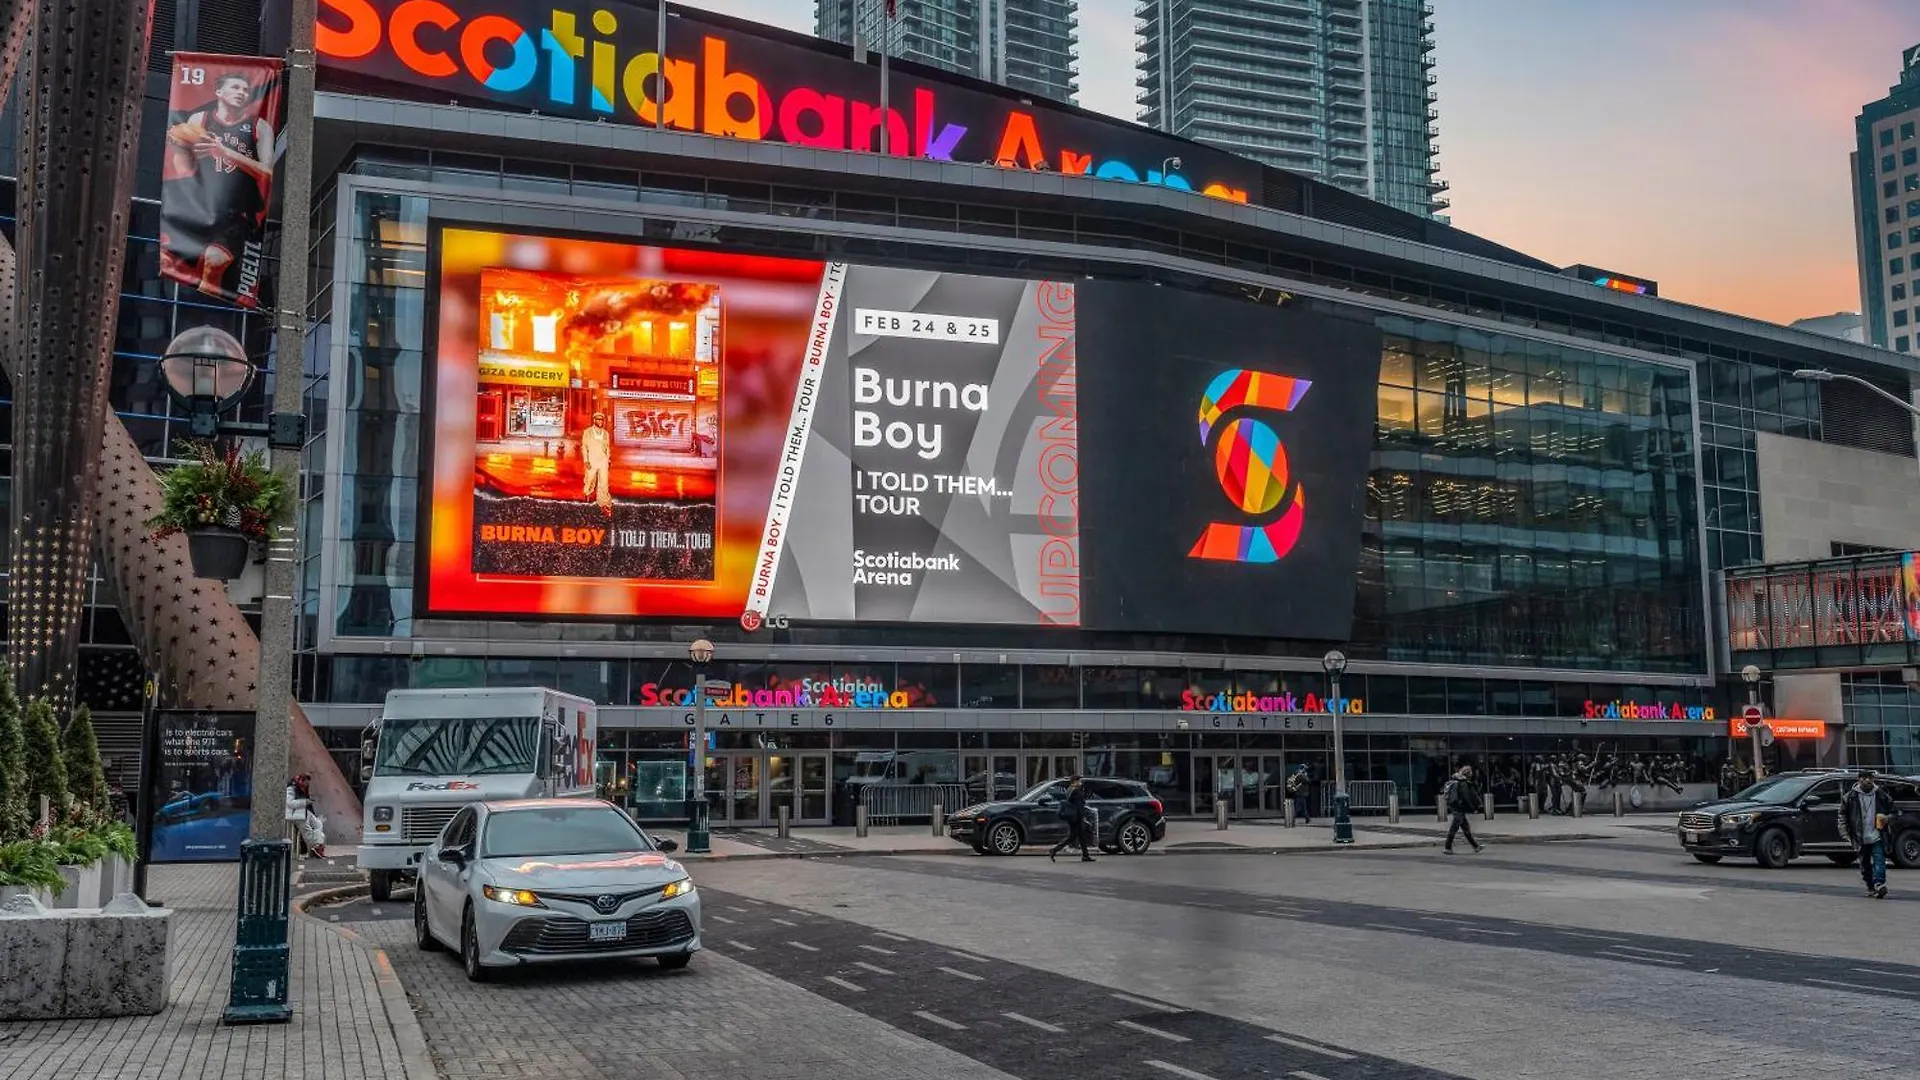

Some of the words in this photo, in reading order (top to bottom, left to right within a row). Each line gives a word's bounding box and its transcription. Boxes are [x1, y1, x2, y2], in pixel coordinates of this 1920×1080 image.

[180, 67, 205, 85] 19
[236, 240, 262, 298] POELTL
[864, 315, 901, 330] FEB
[912, 319, 935, 333] 24
[946, 322, 957, 335] &
[968, 324, 990, 337] 25
[478, 367, 506, 377] GIZA
[509, 369, 564, 381] GROCERY
[854, 366, 989, 411] Burna
[755, 550, 776, 597] BURNA
[767, 518, 782, 548] BOY
[777, 466, 795, 501] TOLD
[798, 377, 816, 413] TOUR
[809, 322, 829, 366] BURNA
[820, 291, 836, 319] BOY
[854, 410, 942, 459] Boy
[1037, 280, 1080, 626] UPCOMING
[856, 470, 862, 489] I
[867, 471, 929, 492] TOLD
[933, 474, 1013, 496] THEM...
[855, 494, 921, 516] TOUR
[480, 525, 556, 544] BURNA
[562, 526, 605, 545] BOY
[619, 529, 646, 548] TOLD
[853, 549, 961, 571] Scotiabank
[852, 568, 913, 586] Arena
[765, 615, 789, 629] LG
[640, 682, 809, 708] Scoabank
[821, 685, 909, 709] Arena
[1182, 688, 1297, 712] Scotiabank
[1303, 692, 1363, 715] Arena
[684, 713, 800, 726] GATE
[824, 713, 834, 726] 6
[1583, 699, 1668, 720] Scotiabank
[1670, 701, 1715, 720] Arena
[1213, 716, 1291, 728] GATE
[1307, 718, 1314, 728] 6
[164, 738, 185, 746] what
[202, 738, 215, 746] 911
[173, 748, 183, 756] to
[406, 781, 481, 792] FedEx
